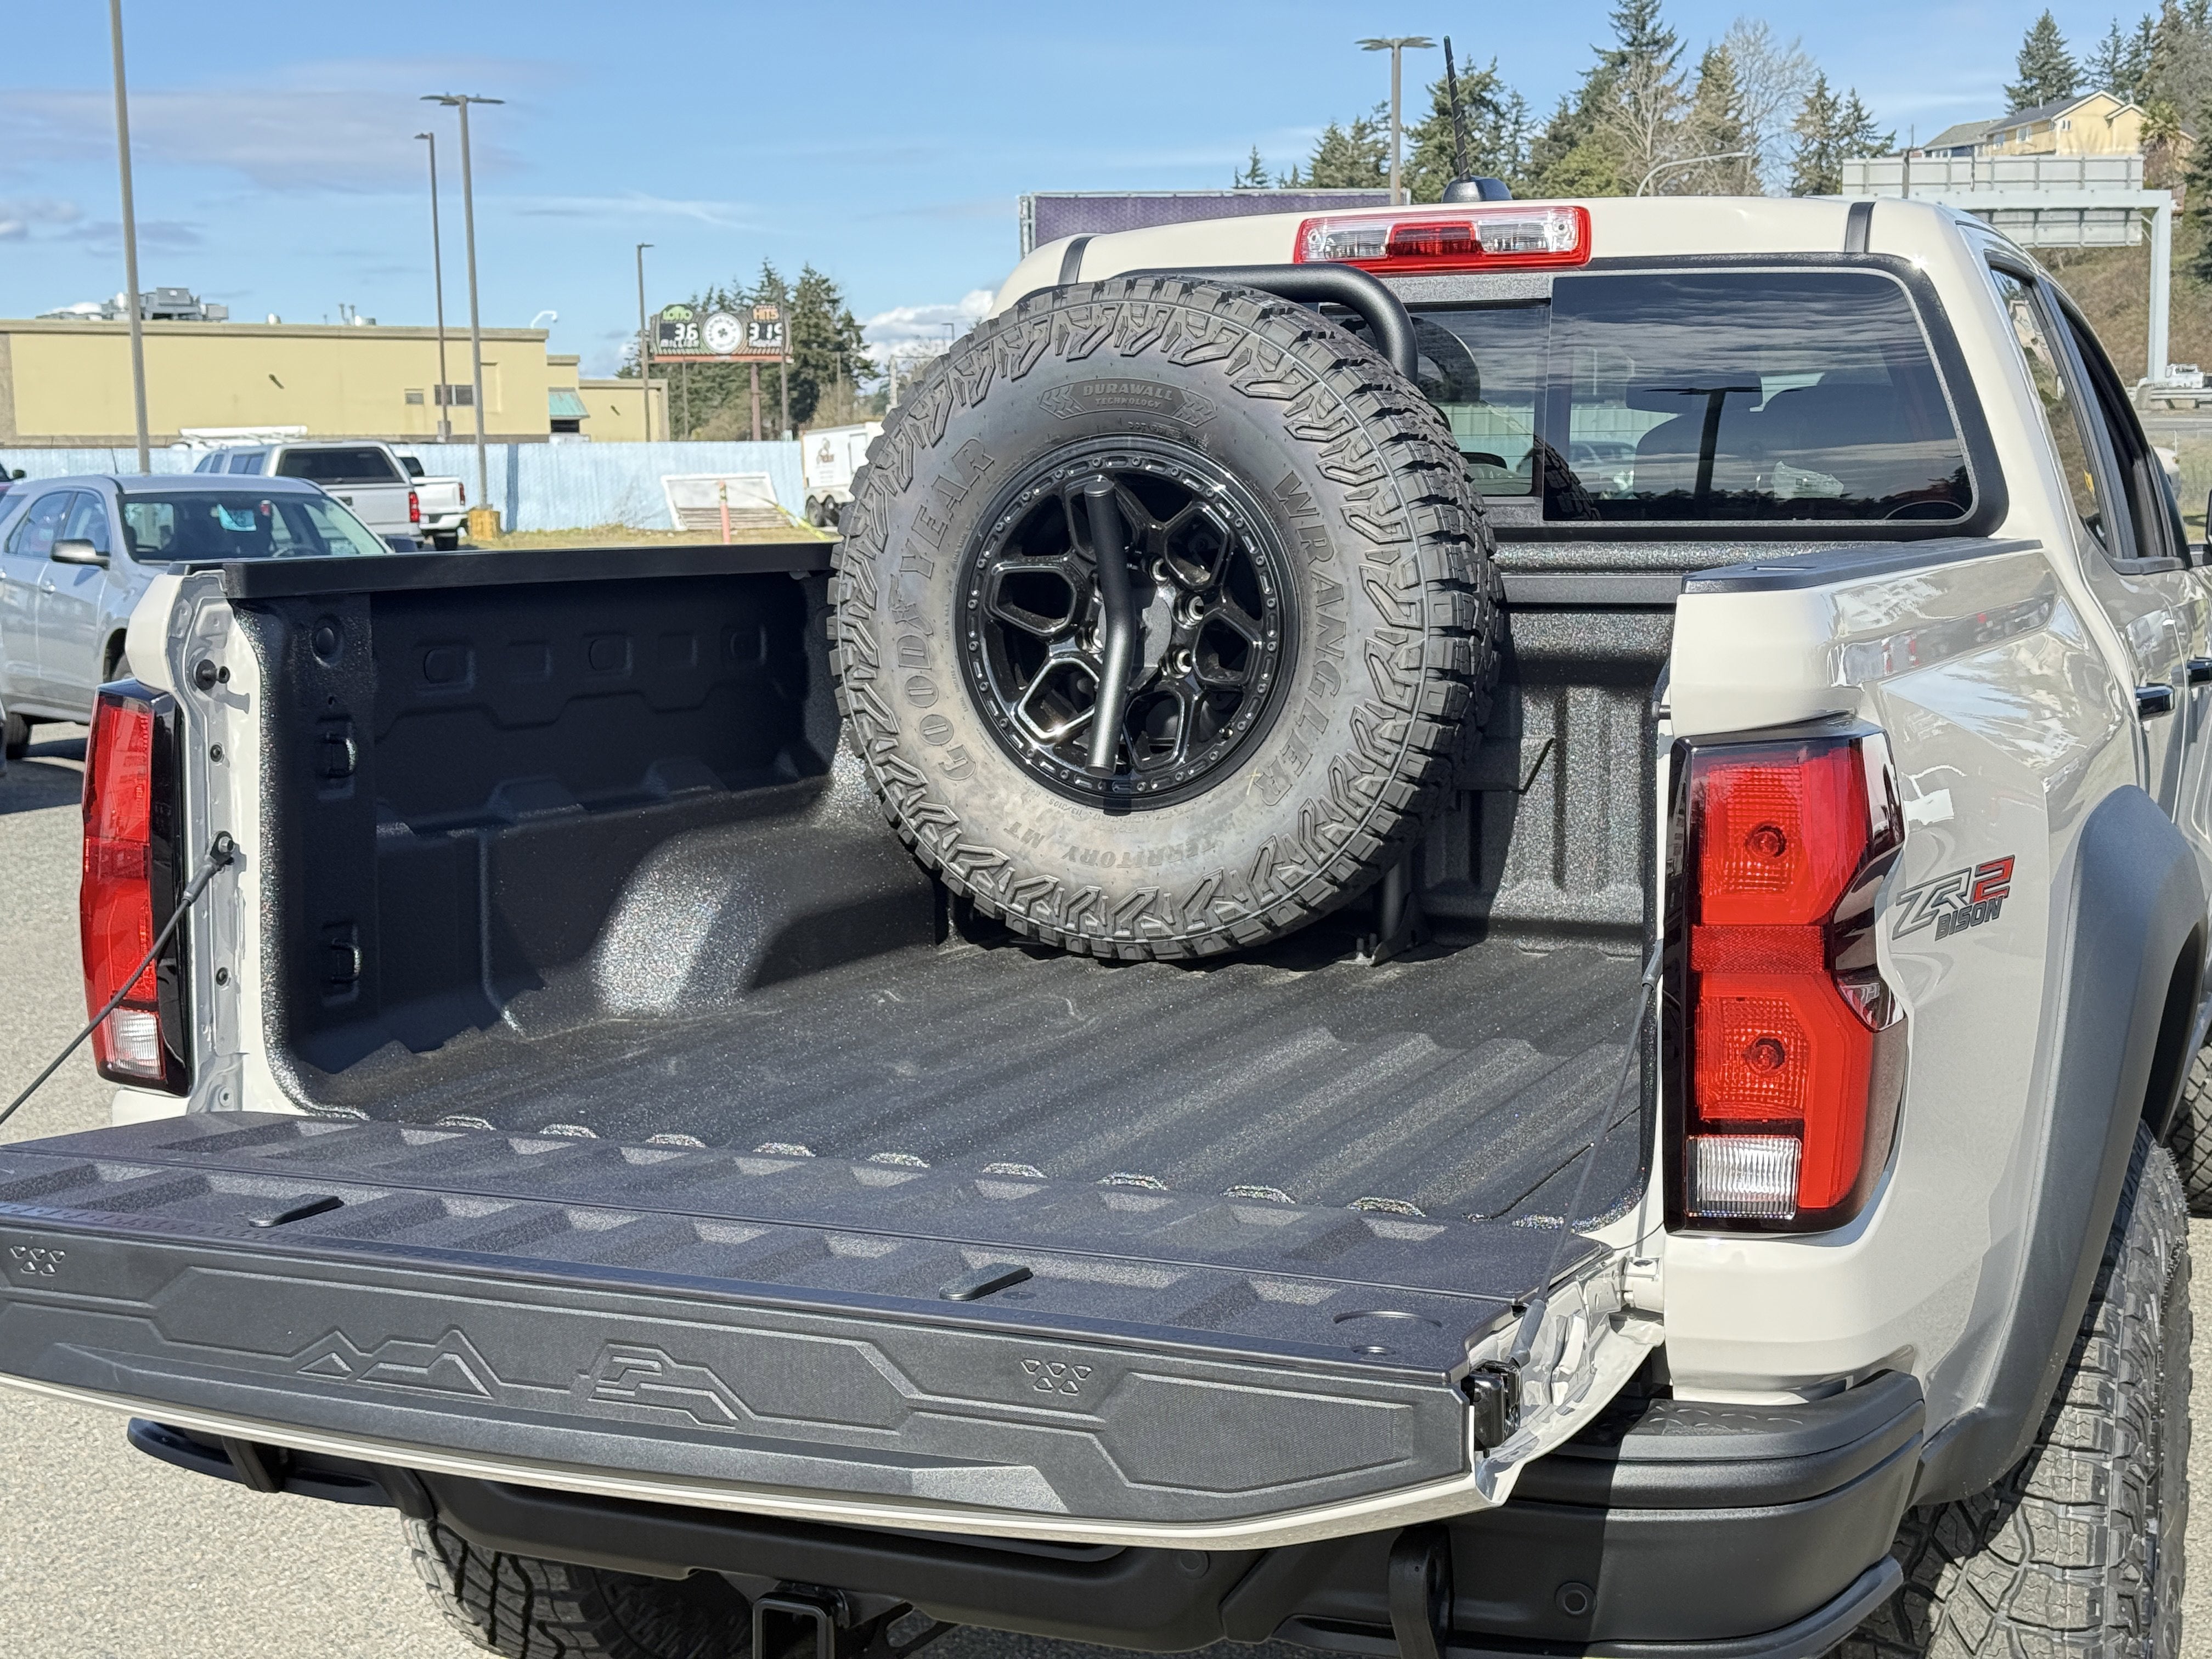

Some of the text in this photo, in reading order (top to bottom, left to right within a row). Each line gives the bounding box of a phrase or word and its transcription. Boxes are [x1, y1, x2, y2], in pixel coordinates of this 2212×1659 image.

[674, 323, 698, 341] 36
[1082, 383, 1173, 400] DURAWALL
[1094, 398, 1161, 409] TECHNOLOGY
[1254, 470, 1347, 806] WRANGLER
[1003, 821, 1221, 868] TERRITORY MT
[1892, 854, 2016, 941] ZR2
[1934, 895, 2004, 941] BISON
